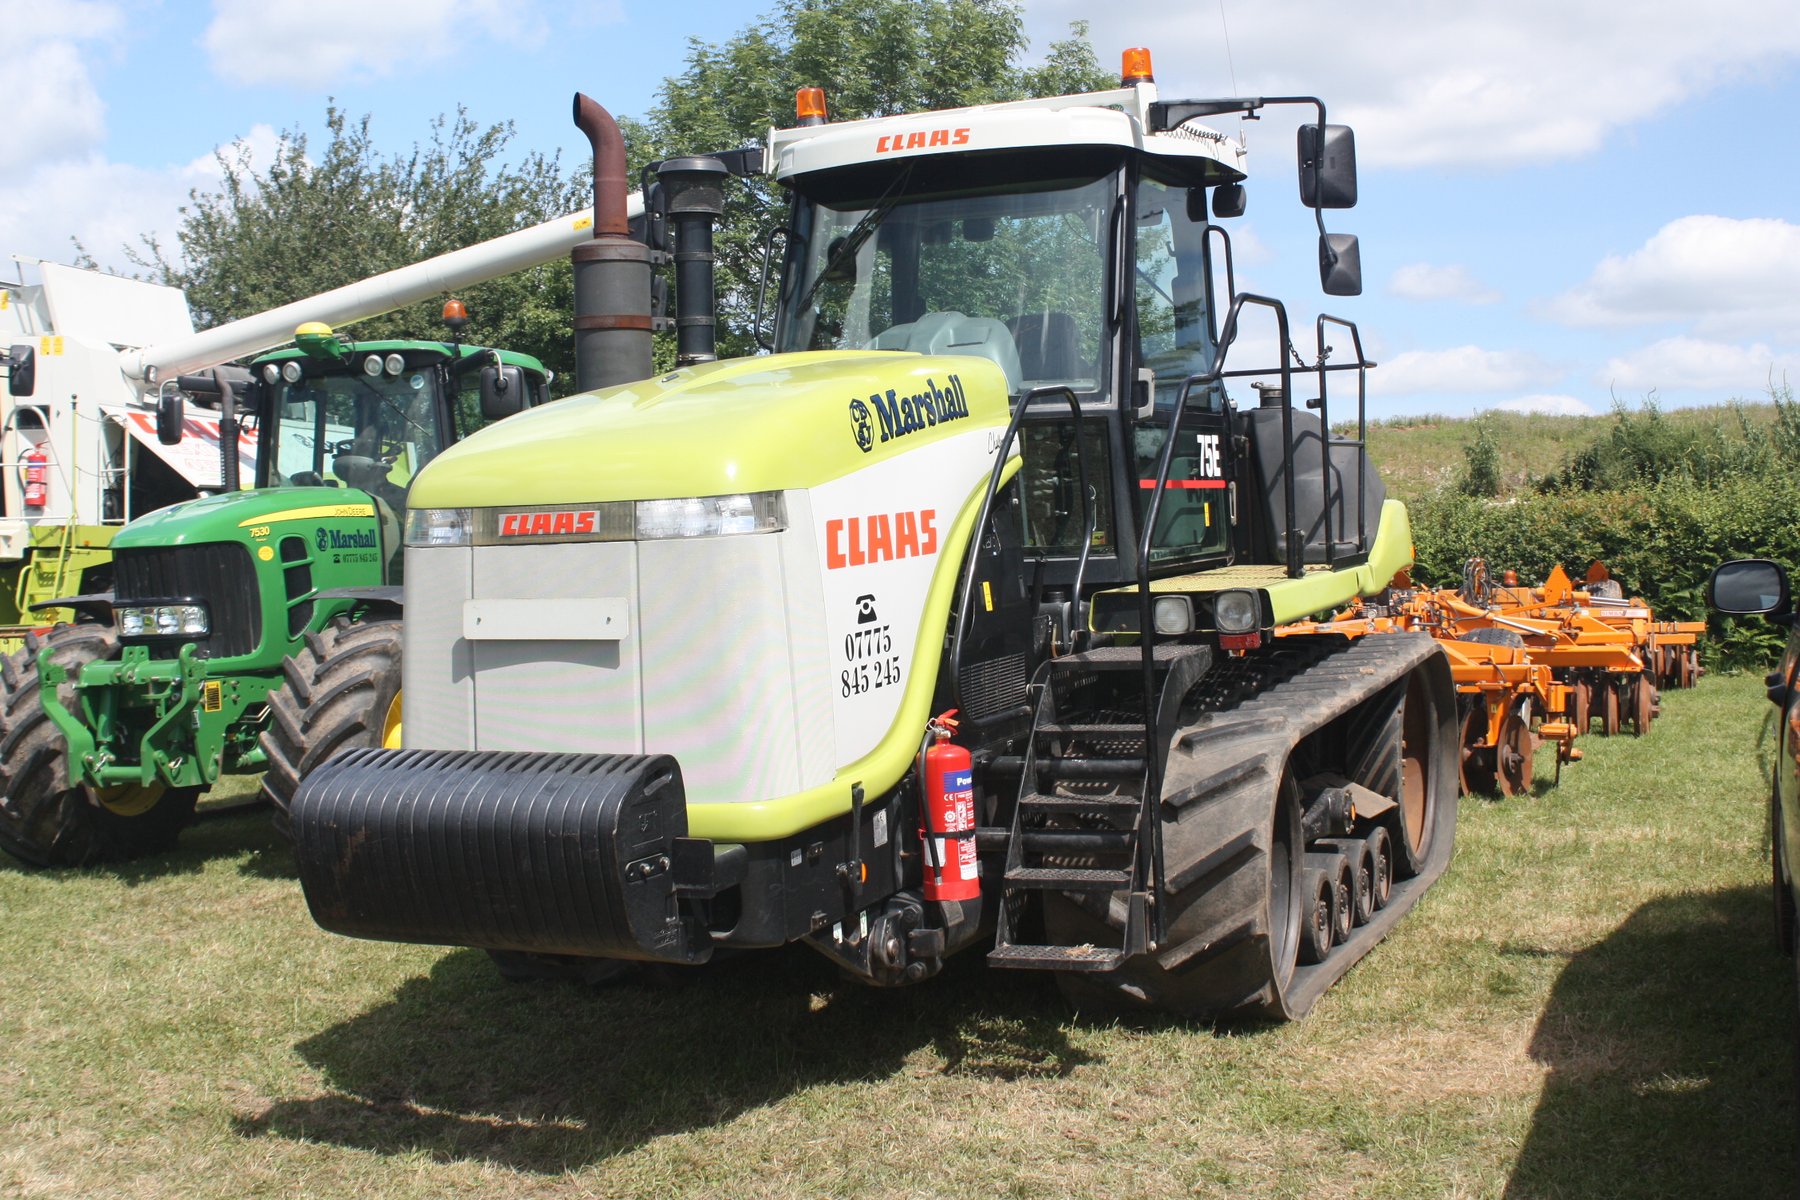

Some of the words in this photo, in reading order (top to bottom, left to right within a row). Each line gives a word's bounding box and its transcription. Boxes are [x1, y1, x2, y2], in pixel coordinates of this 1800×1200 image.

[876, 128, 970, 153] CLAAS
[870, 374, 969, 443] Marshall
[1196, 434, 1221, 477] 75E
[334, 507, 348, 516] JOHN
[348, 506, 366, 516] DEERE
[502, 511, 596, 535] CLAAS
[249, 526, 270, 538] 7530
[328, 528, 377, 549] Marshall
[826, 509, 937, 570] CLAAS
[845, 625, 892, 662] 07775
[841, 664, 869, 698] 845
[874, 656, 901, 689] 245
